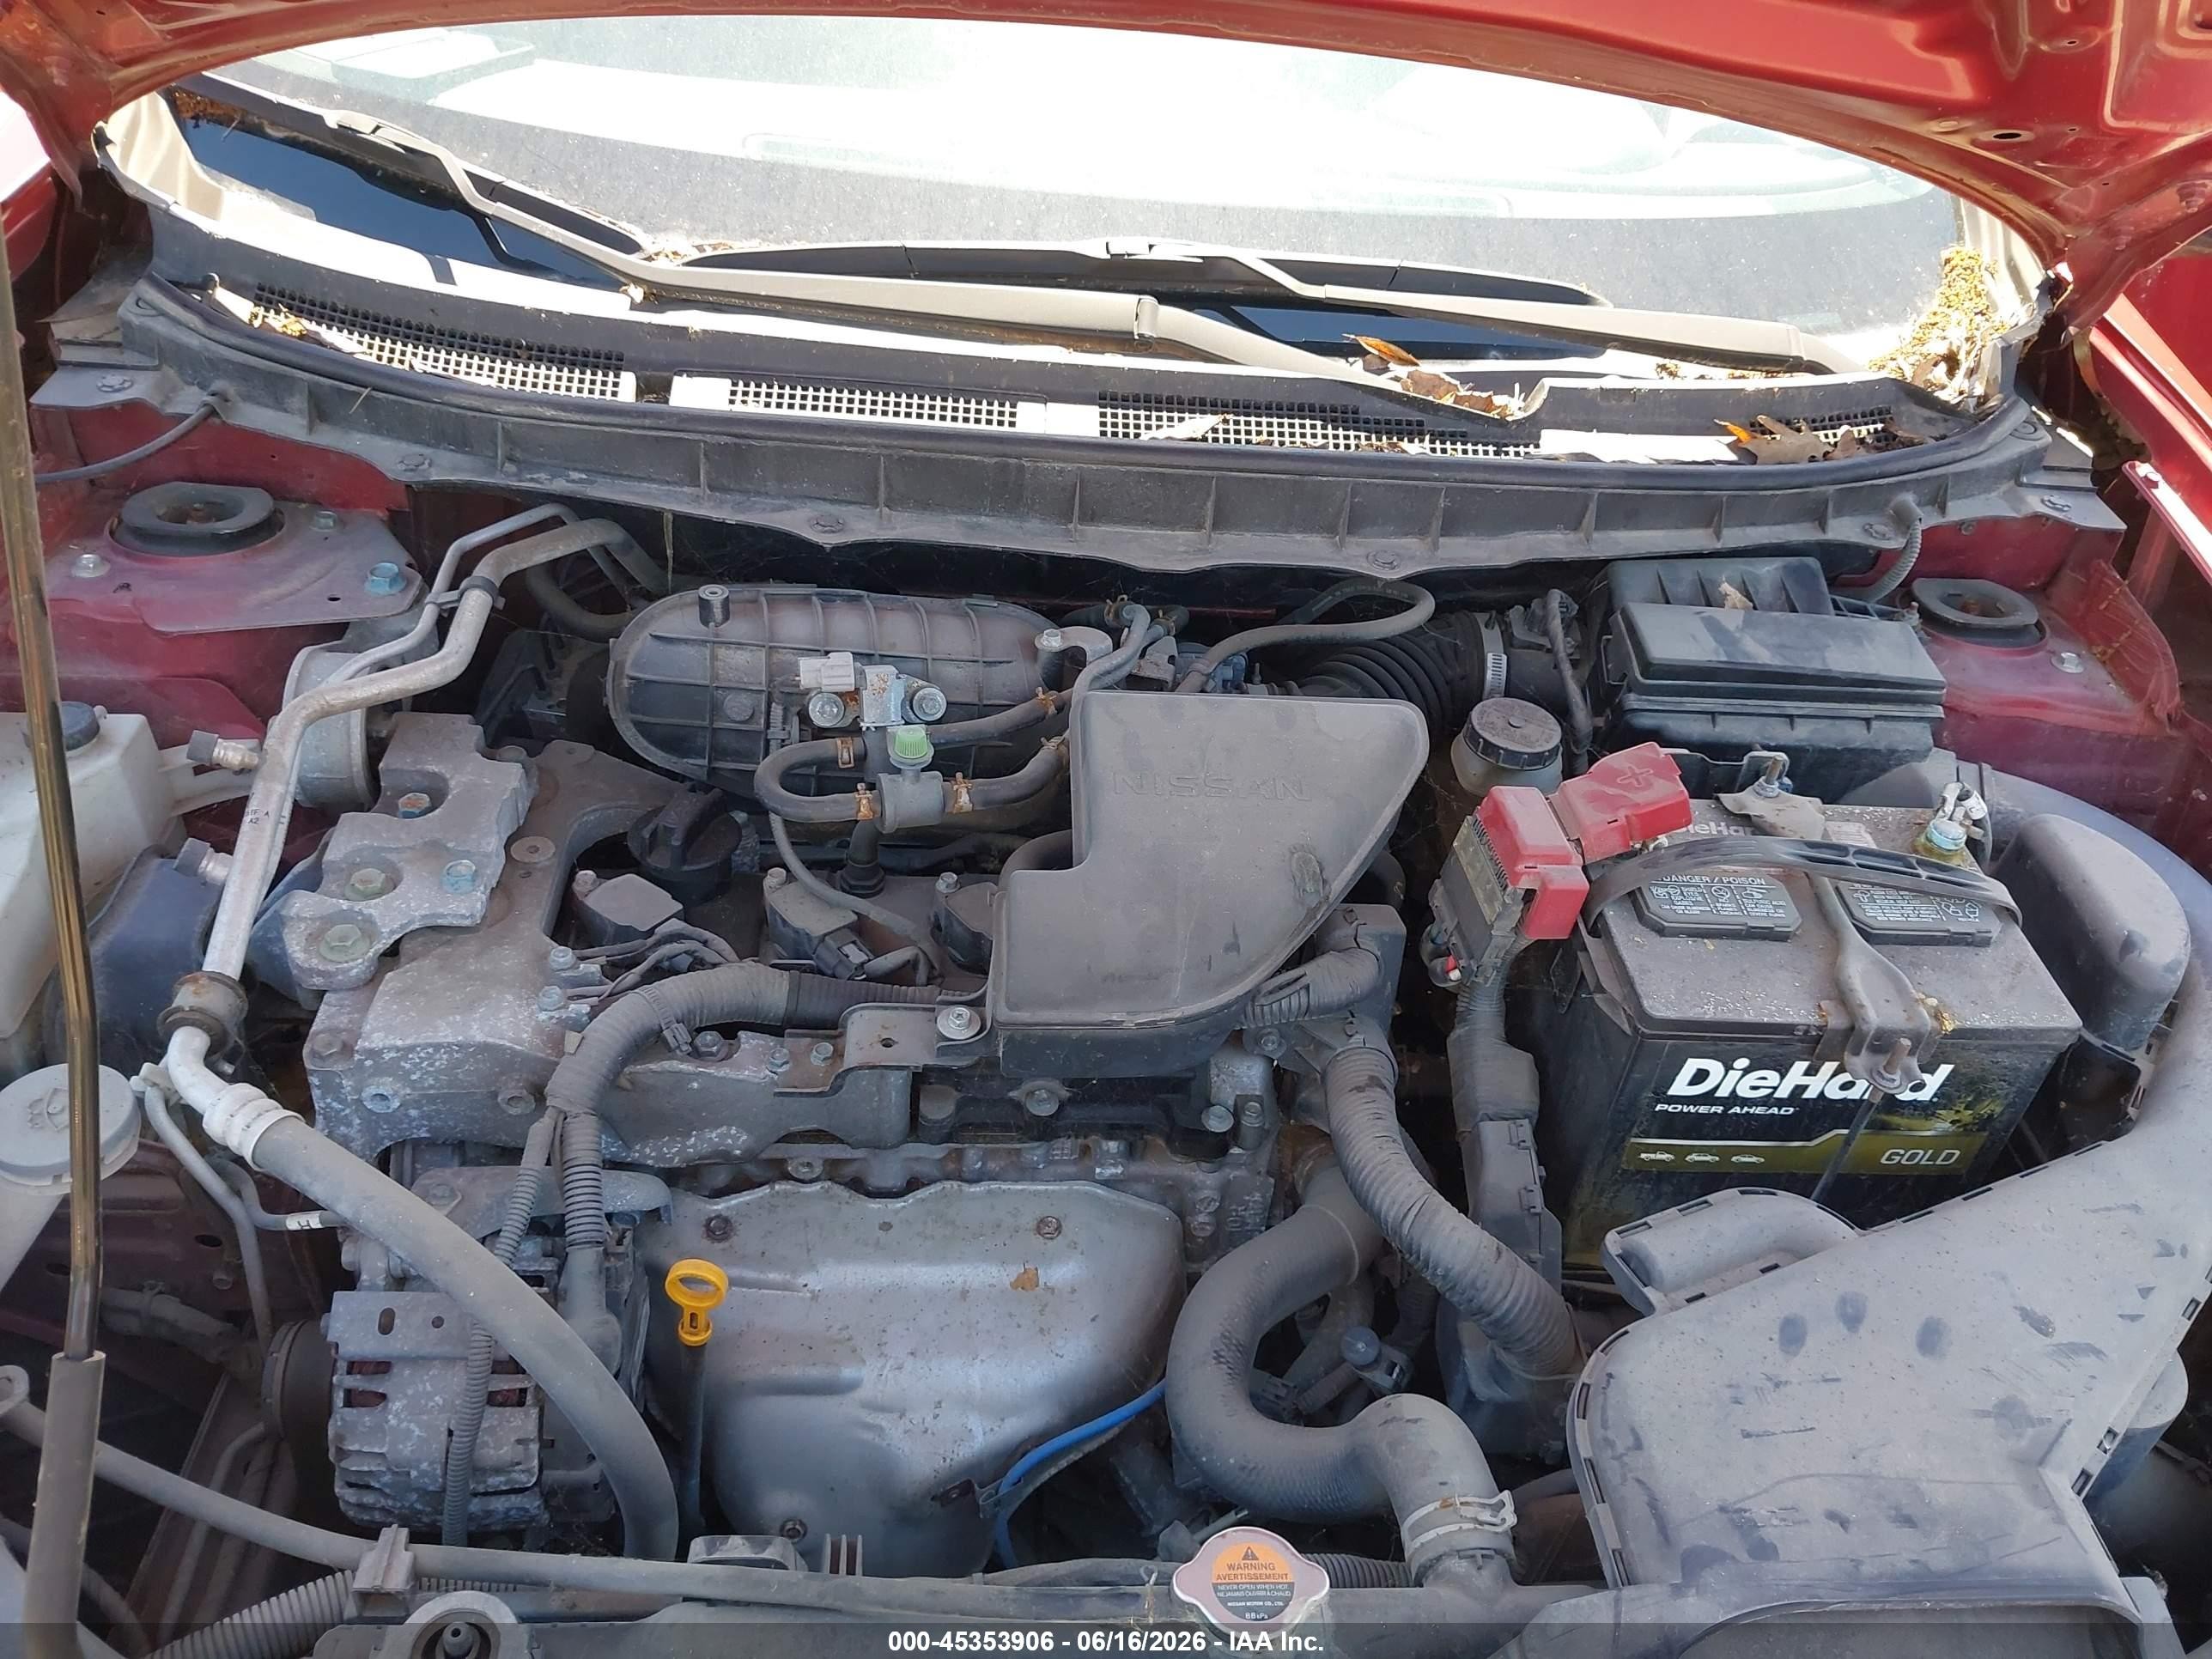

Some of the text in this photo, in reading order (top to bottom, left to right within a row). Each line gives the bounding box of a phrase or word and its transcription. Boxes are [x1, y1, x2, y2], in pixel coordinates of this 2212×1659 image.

[1113, 772, 1312, 801] NISSAN
[1722, 877, 1766, 885] POISON
[1667, 1058, 1954, 1102] DieHad
[1655, 1103, 1796, 1115] POWER AHEAD
[1880, 1149, 1961, 1166] GOLD
[1226, 1562, 1276, 1571] WARNING
[1216, 1572, 1289, 1581] AVERTISSEMENT
